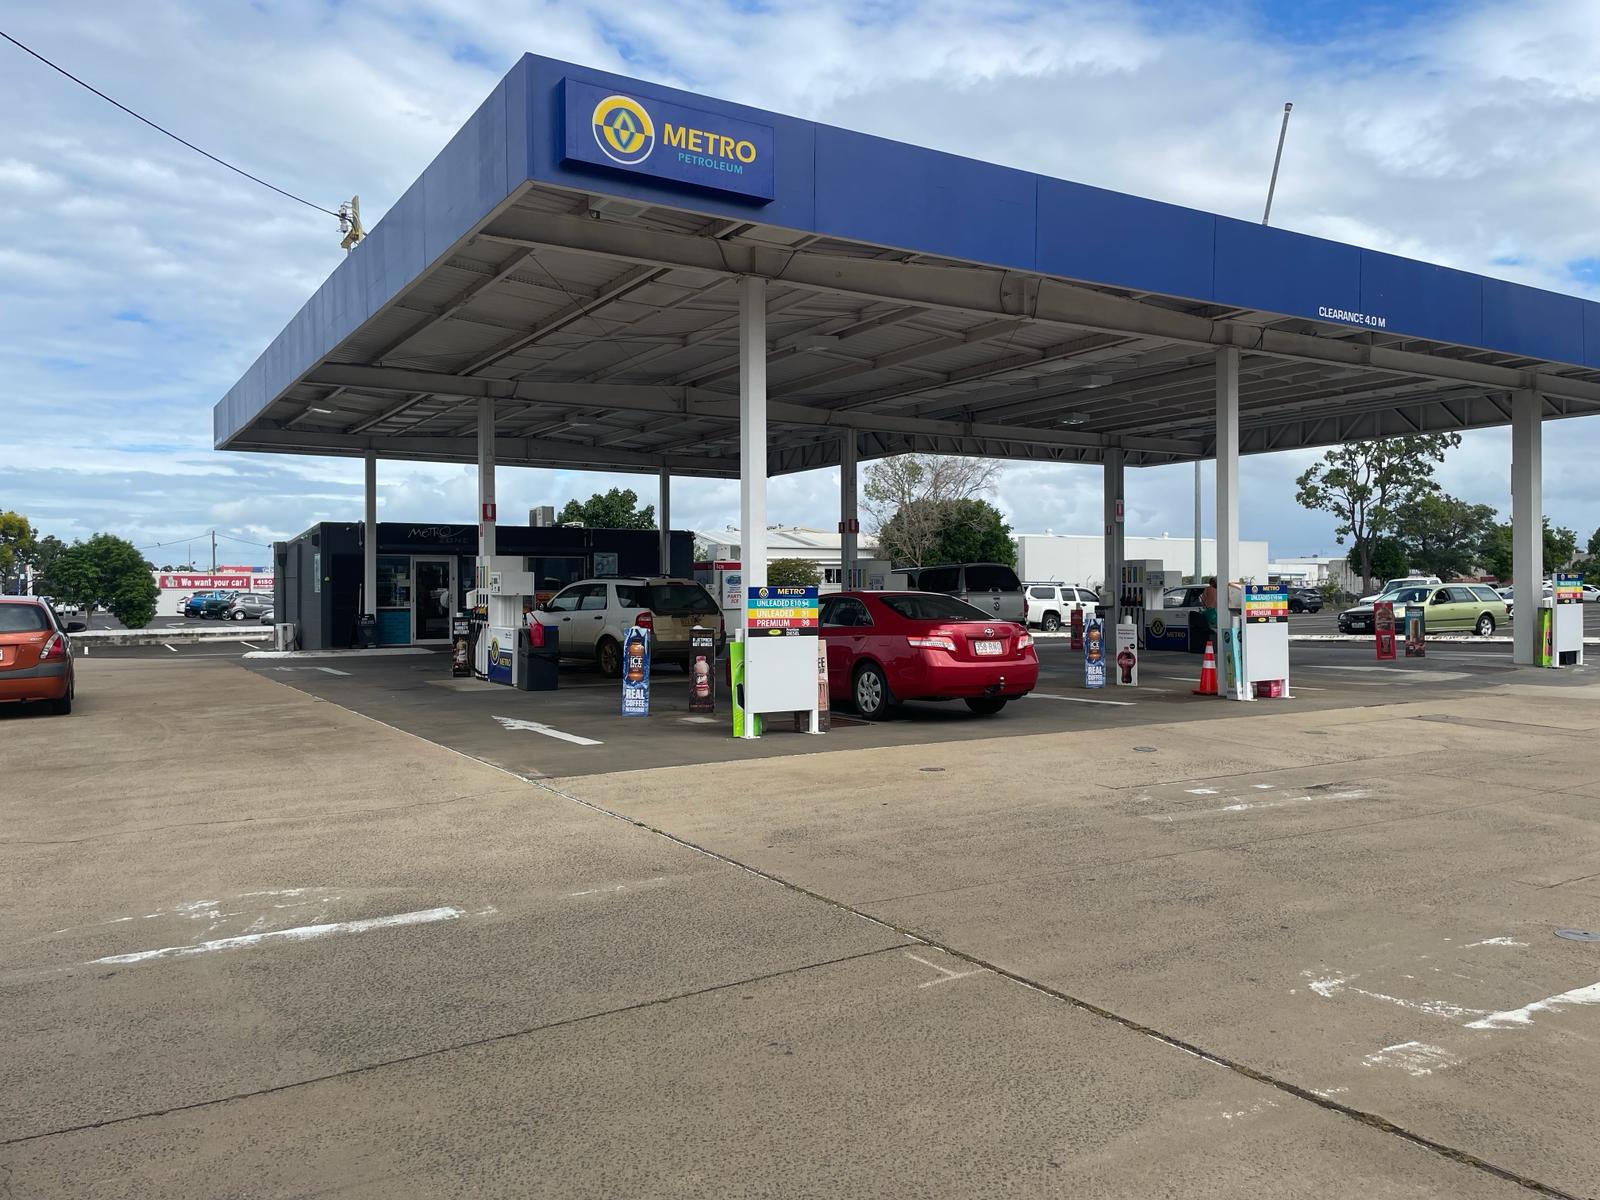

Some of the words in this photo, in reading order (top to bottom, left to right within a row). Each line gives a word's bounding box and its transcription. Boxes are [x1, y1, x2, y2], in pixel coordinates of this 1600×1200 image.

[663, 122, 757, 164] METRO
[678, 152, 743, 175] PETROLEUM
[1318, 306, 1364, 324] CLEARANCE
[1364, 315, 1377, 326] 4.0
[1378, 317, 1386, 328] M
[181, 578, 192, 587] We
[194, 578, 212, 587] want
[213, 579, 230, 588] your
[756, 599, 790, 607] UNLEADED
[790, 599, 801, 607] E10
[756, 609, 795, 618] UNLEADED
[756, 619, 791, 627] PREMIUM
[1087, 666, 1103, 675] REAL
[625, 688, 646, 700] REAL
